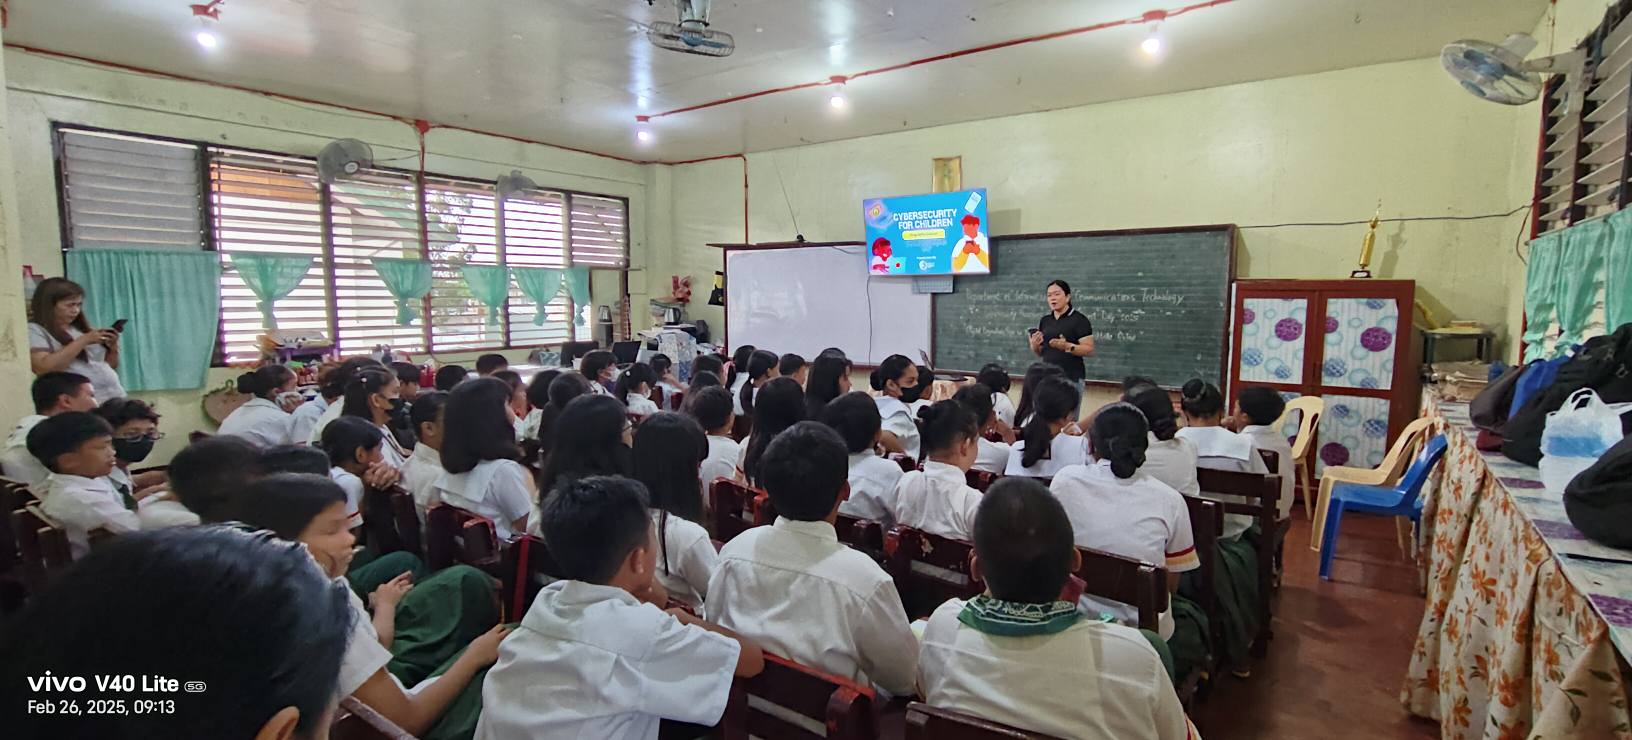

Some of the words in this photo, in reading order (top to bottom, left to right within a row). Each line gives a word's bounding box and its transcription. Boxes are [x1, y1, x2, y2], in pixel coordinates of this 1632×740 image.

[893, 208, 957, 221] CYBERSECURITY
[898, 221, 914, 230] FOR
[914, 218, 953, 229] CHILDREN
[1140, 288, 1185, 305] Technology
